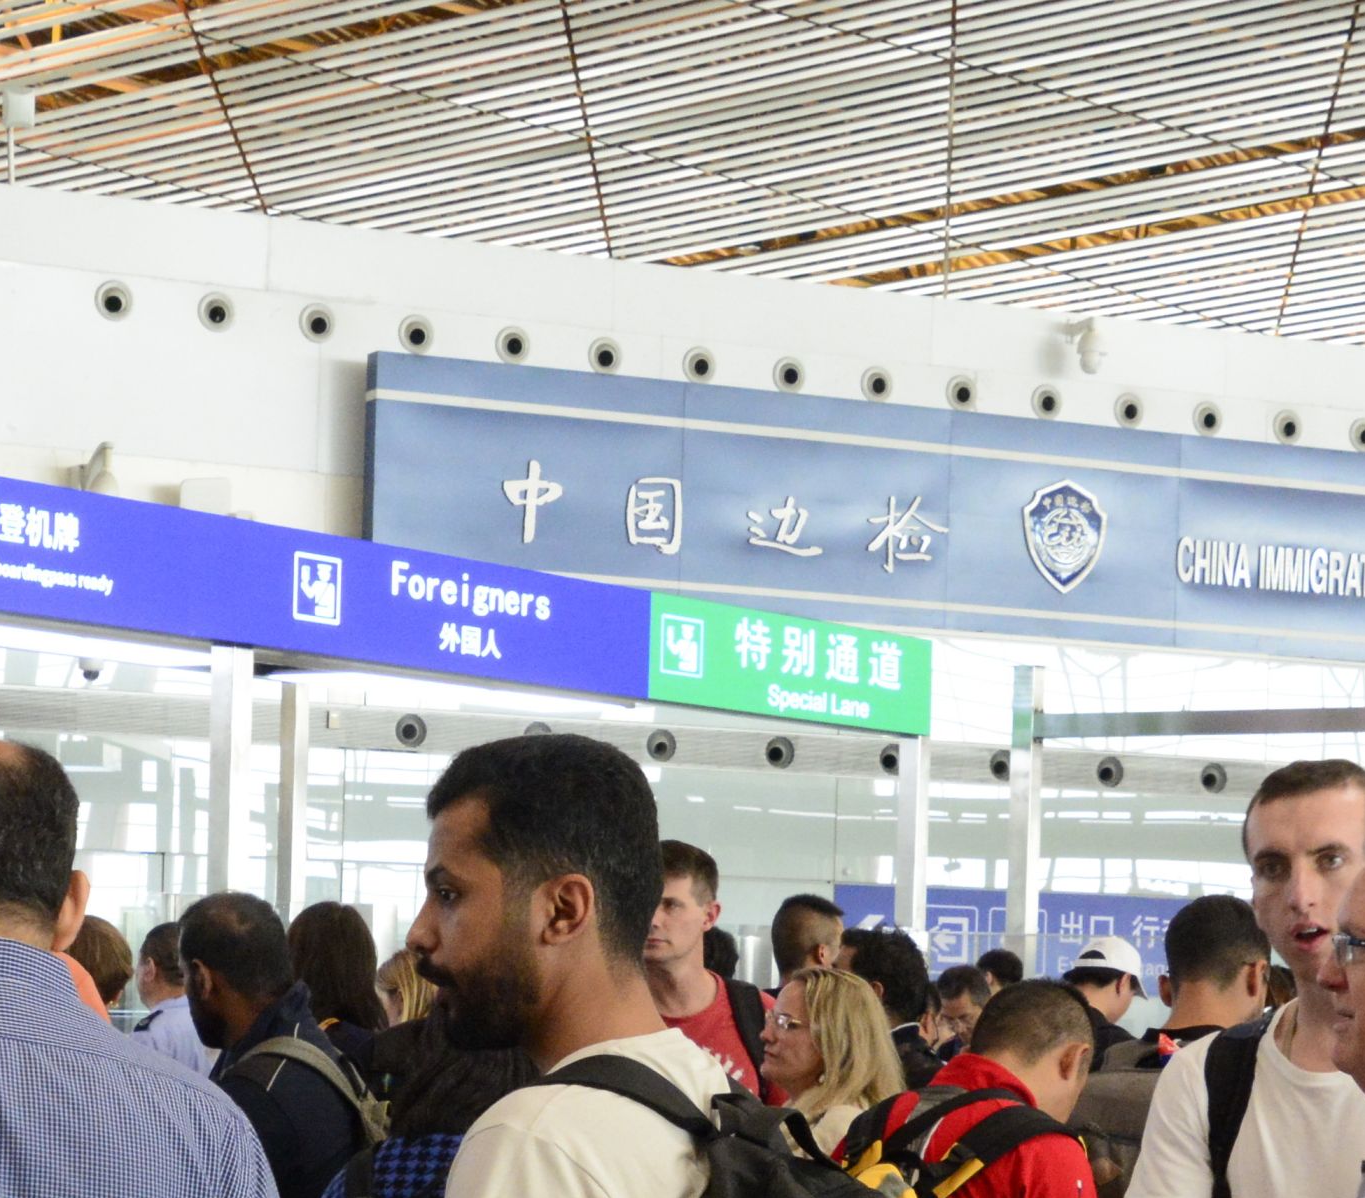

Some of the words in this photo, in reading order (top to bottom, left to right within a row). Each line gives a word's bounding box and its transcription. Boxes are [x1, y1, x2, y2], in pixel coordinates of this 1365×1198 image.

[503, 460, 950, 573] 中国边检
[78, 574, 114, 596] ready
[1176, 536, 1251, 589] CHINA
[391, 561, 551, 620] Foreigners
[439, 622, 502, 660] 外国人
[735, 616, 904, 690] 特别通道
[767, 684, 828, 713] Special
[830, 693, 871, 719] Lane
